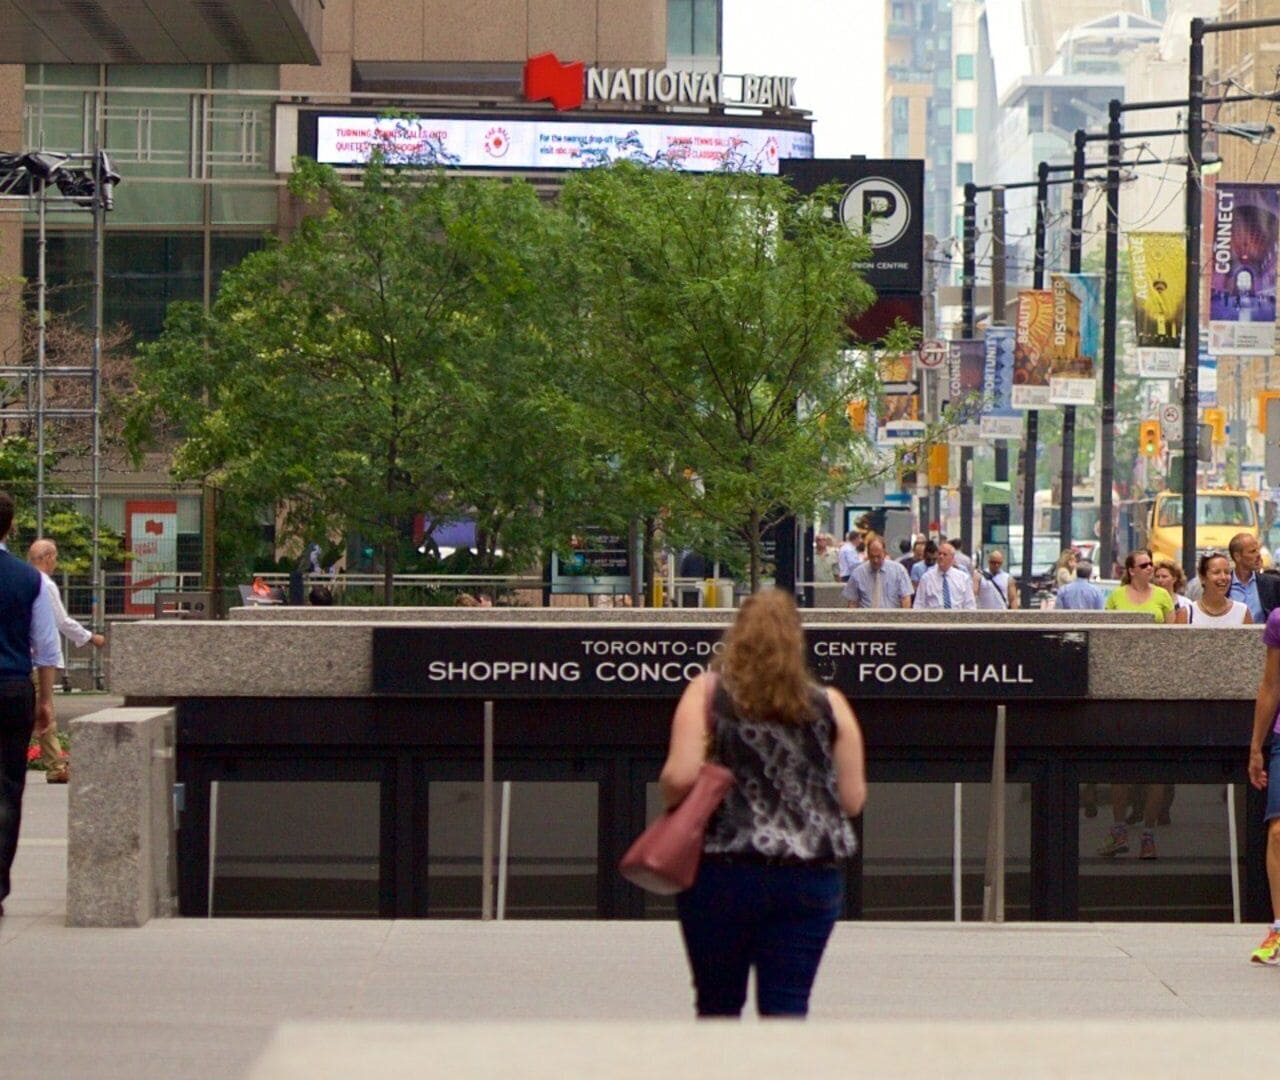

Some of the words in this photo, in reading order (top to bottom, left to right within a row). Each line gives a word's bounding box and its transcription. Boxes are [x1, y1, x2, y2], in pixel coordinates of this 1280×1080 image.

[586, 67, 732, 105] NATIONAL
[743, 74, 798, 107] BANK
[862, 190, 897, 236] P
[1215, 188, 1234, 275] CONNECT
[1131, 236, 1148, 299] ACHIEVE
[1017, 295, 1031, 344] BEAUTY
[1054, 281, 1067, 345] DISCOVER
[951, 345, 961, 397] CONNECT
[428, 661, 580, 682] SHOPPING
[859, 663, 943, 683] FOOD
[960, 664, 1033, 683] HALL
[582, 640, 728, 656] TORONTO-DO
[814, 641, 897, 656] CENTRE
